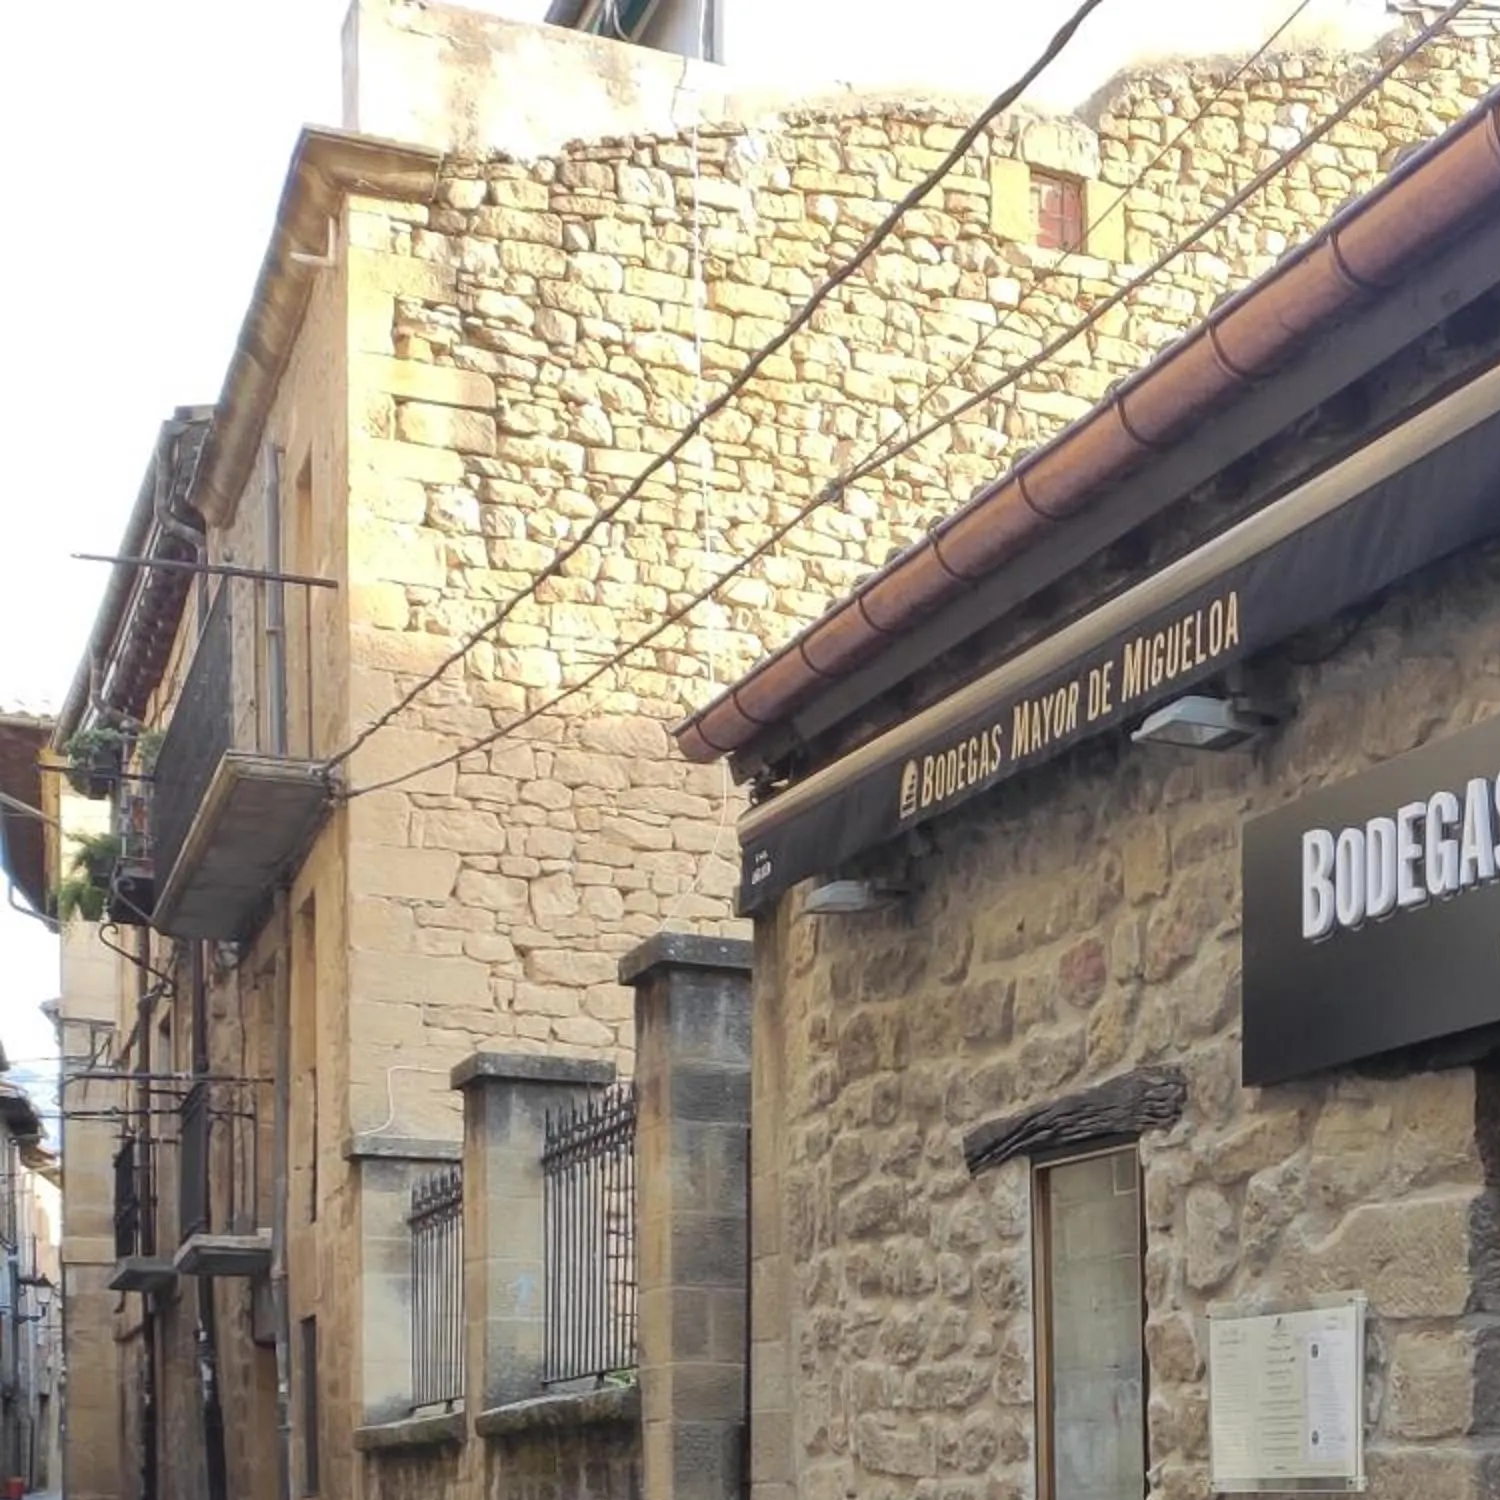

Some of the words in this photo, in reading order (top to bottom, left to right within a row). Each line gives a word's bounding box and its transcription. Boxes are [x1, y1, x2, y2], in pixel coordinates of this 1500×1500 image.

[921, 724, 1002, 807] BODEGAS
[1011, 681, 1079, 760] MAYOR
[1087, 659, 1113, 721] DE
[1121, 591, 1240, 703] MIGUELOA
